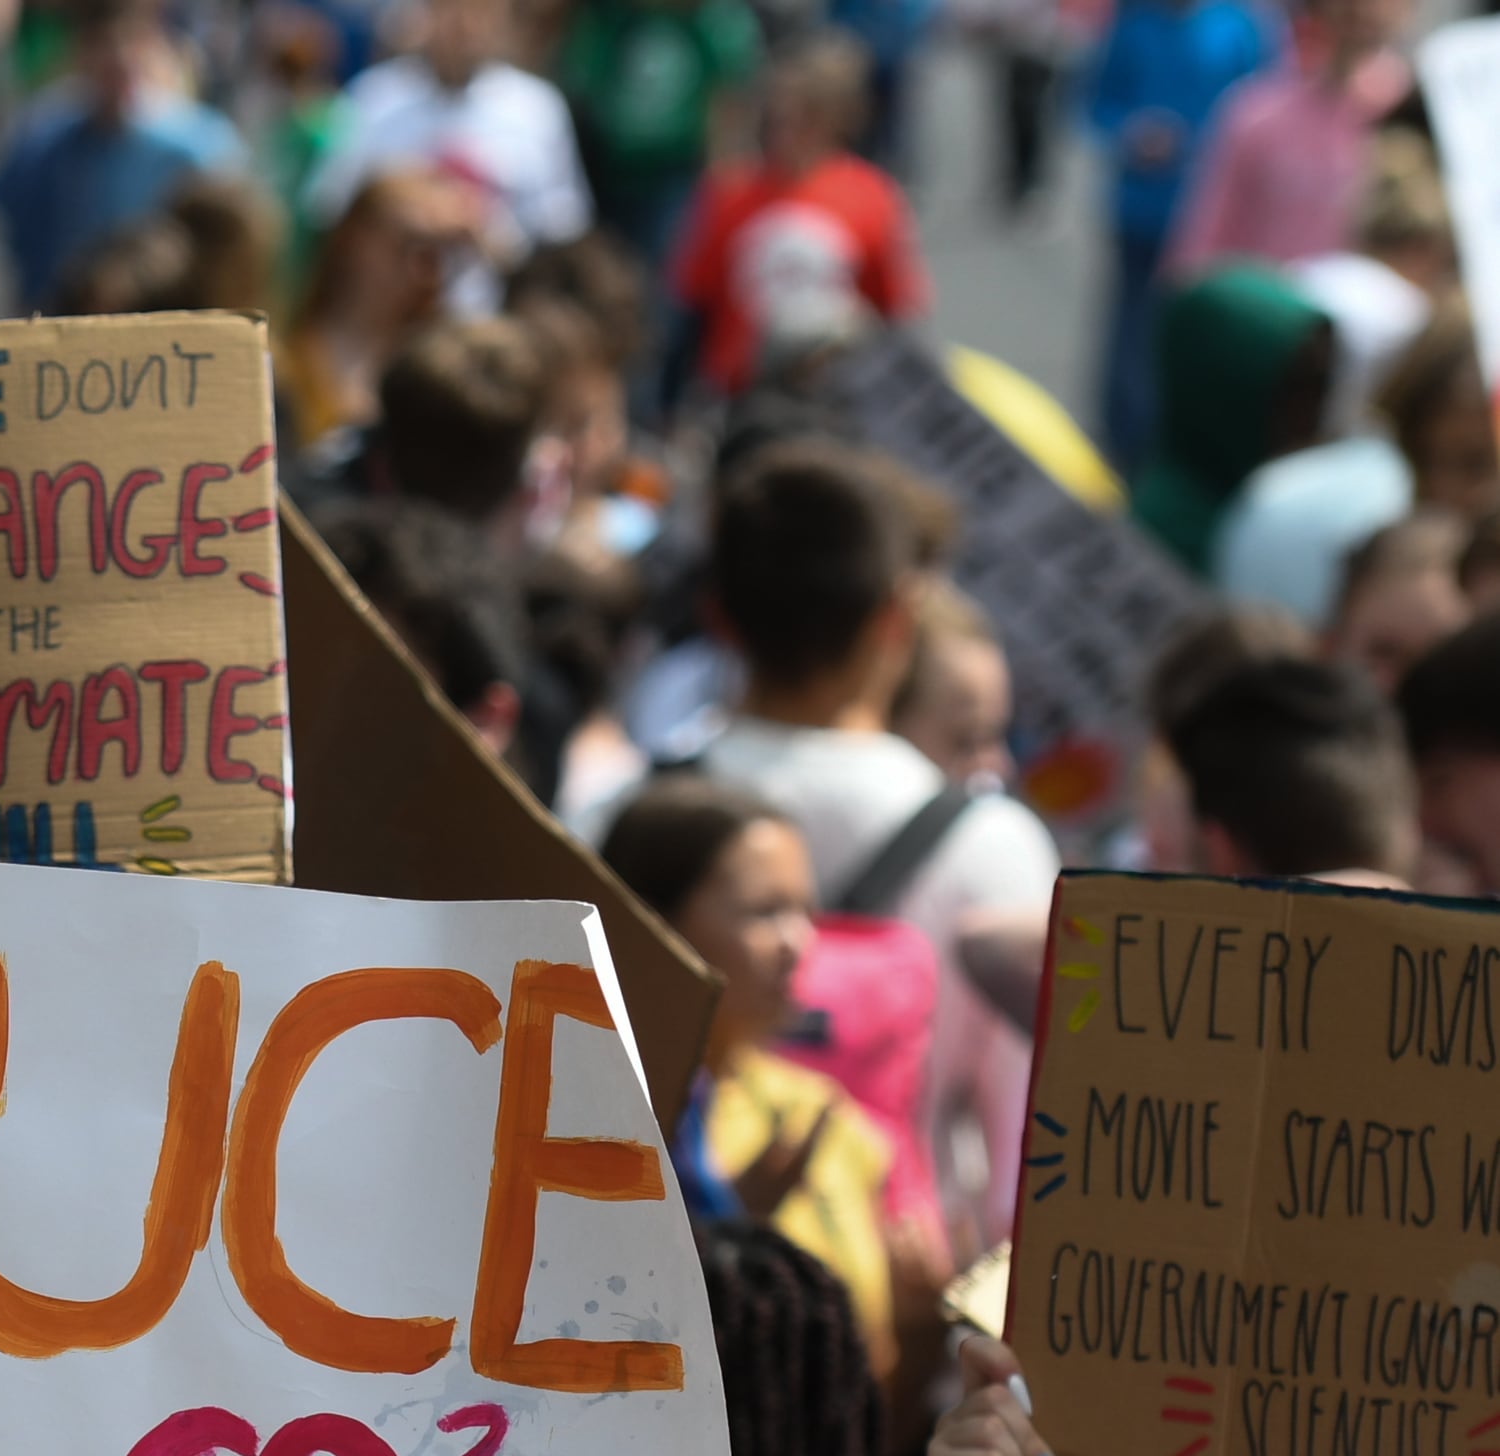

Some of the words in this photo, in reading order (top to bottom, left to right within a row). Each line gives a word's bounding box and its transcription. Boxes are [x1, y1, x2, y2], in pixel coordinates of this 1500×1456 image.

[1111, 914, 1331, 1053] EVERY
[1080, 1087, 1224, 1209] MOVIE
[1275, 1108, 1437, 1230] STARTS
[1046, 1241, 1350, 1380] GOVERNMENT
